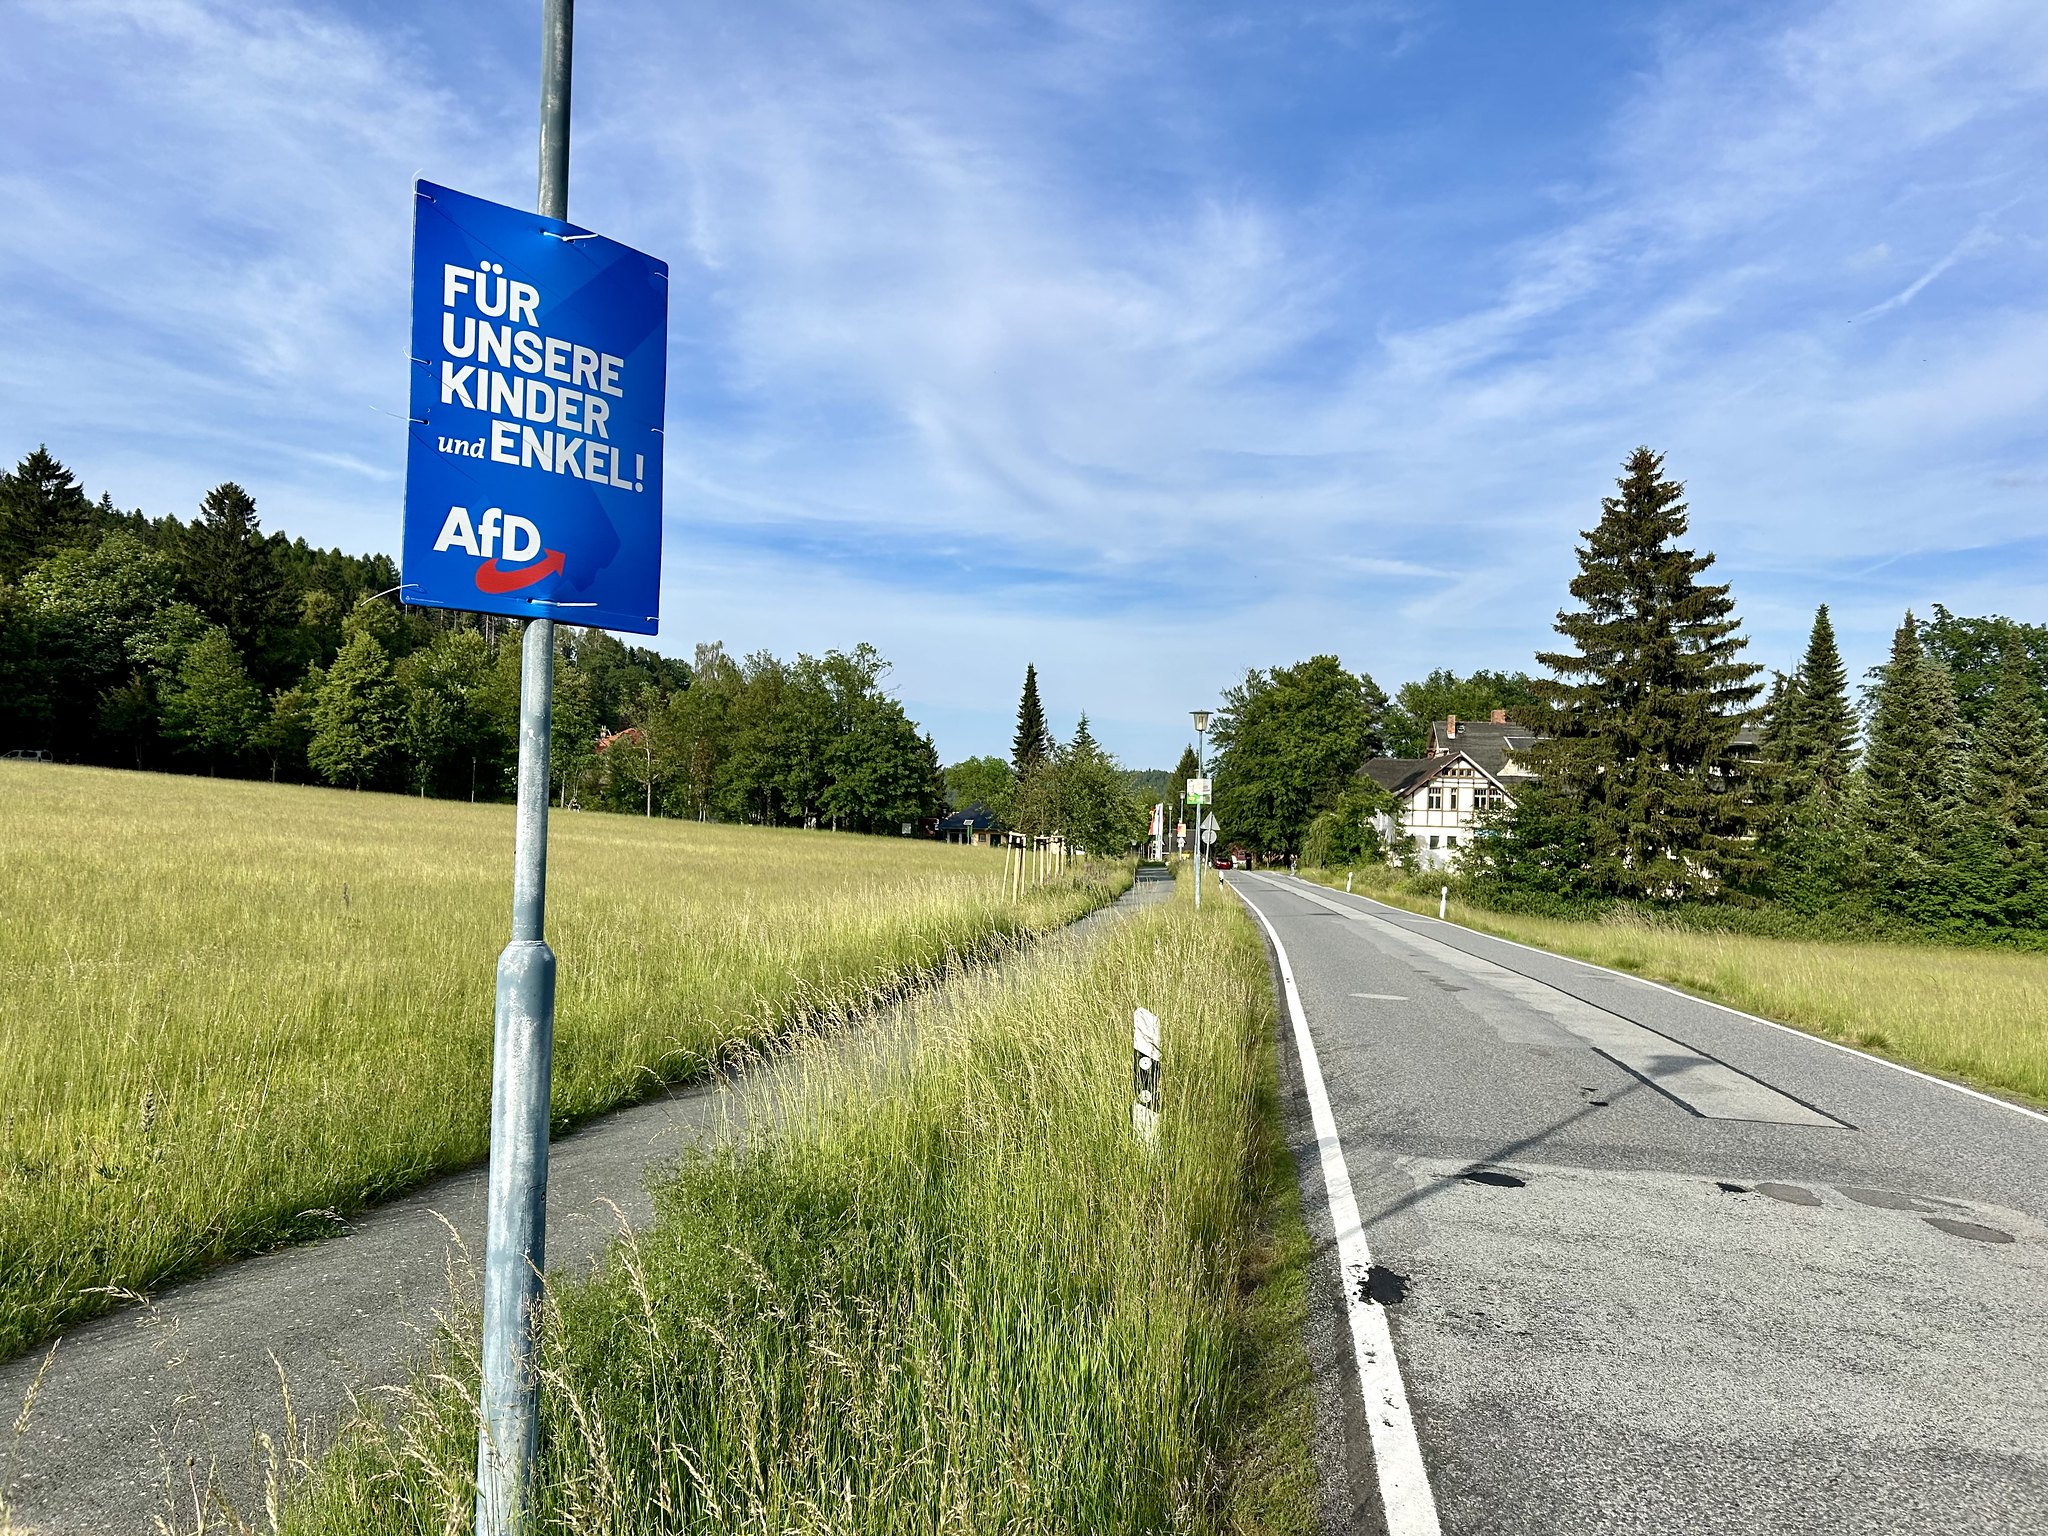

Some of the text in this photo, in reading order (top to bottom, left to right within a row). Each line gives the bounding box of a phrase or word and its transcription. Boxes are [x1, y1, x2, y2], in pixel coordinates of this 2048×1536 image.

[444, 261, 540, 328] FÜR
[443, 313, 624, 397] UNSERE
[442, 362, 610, 439] KINDER
[438, 420, 644, 493] und ENKEL!
[433, 506, 541, 562] AfD
